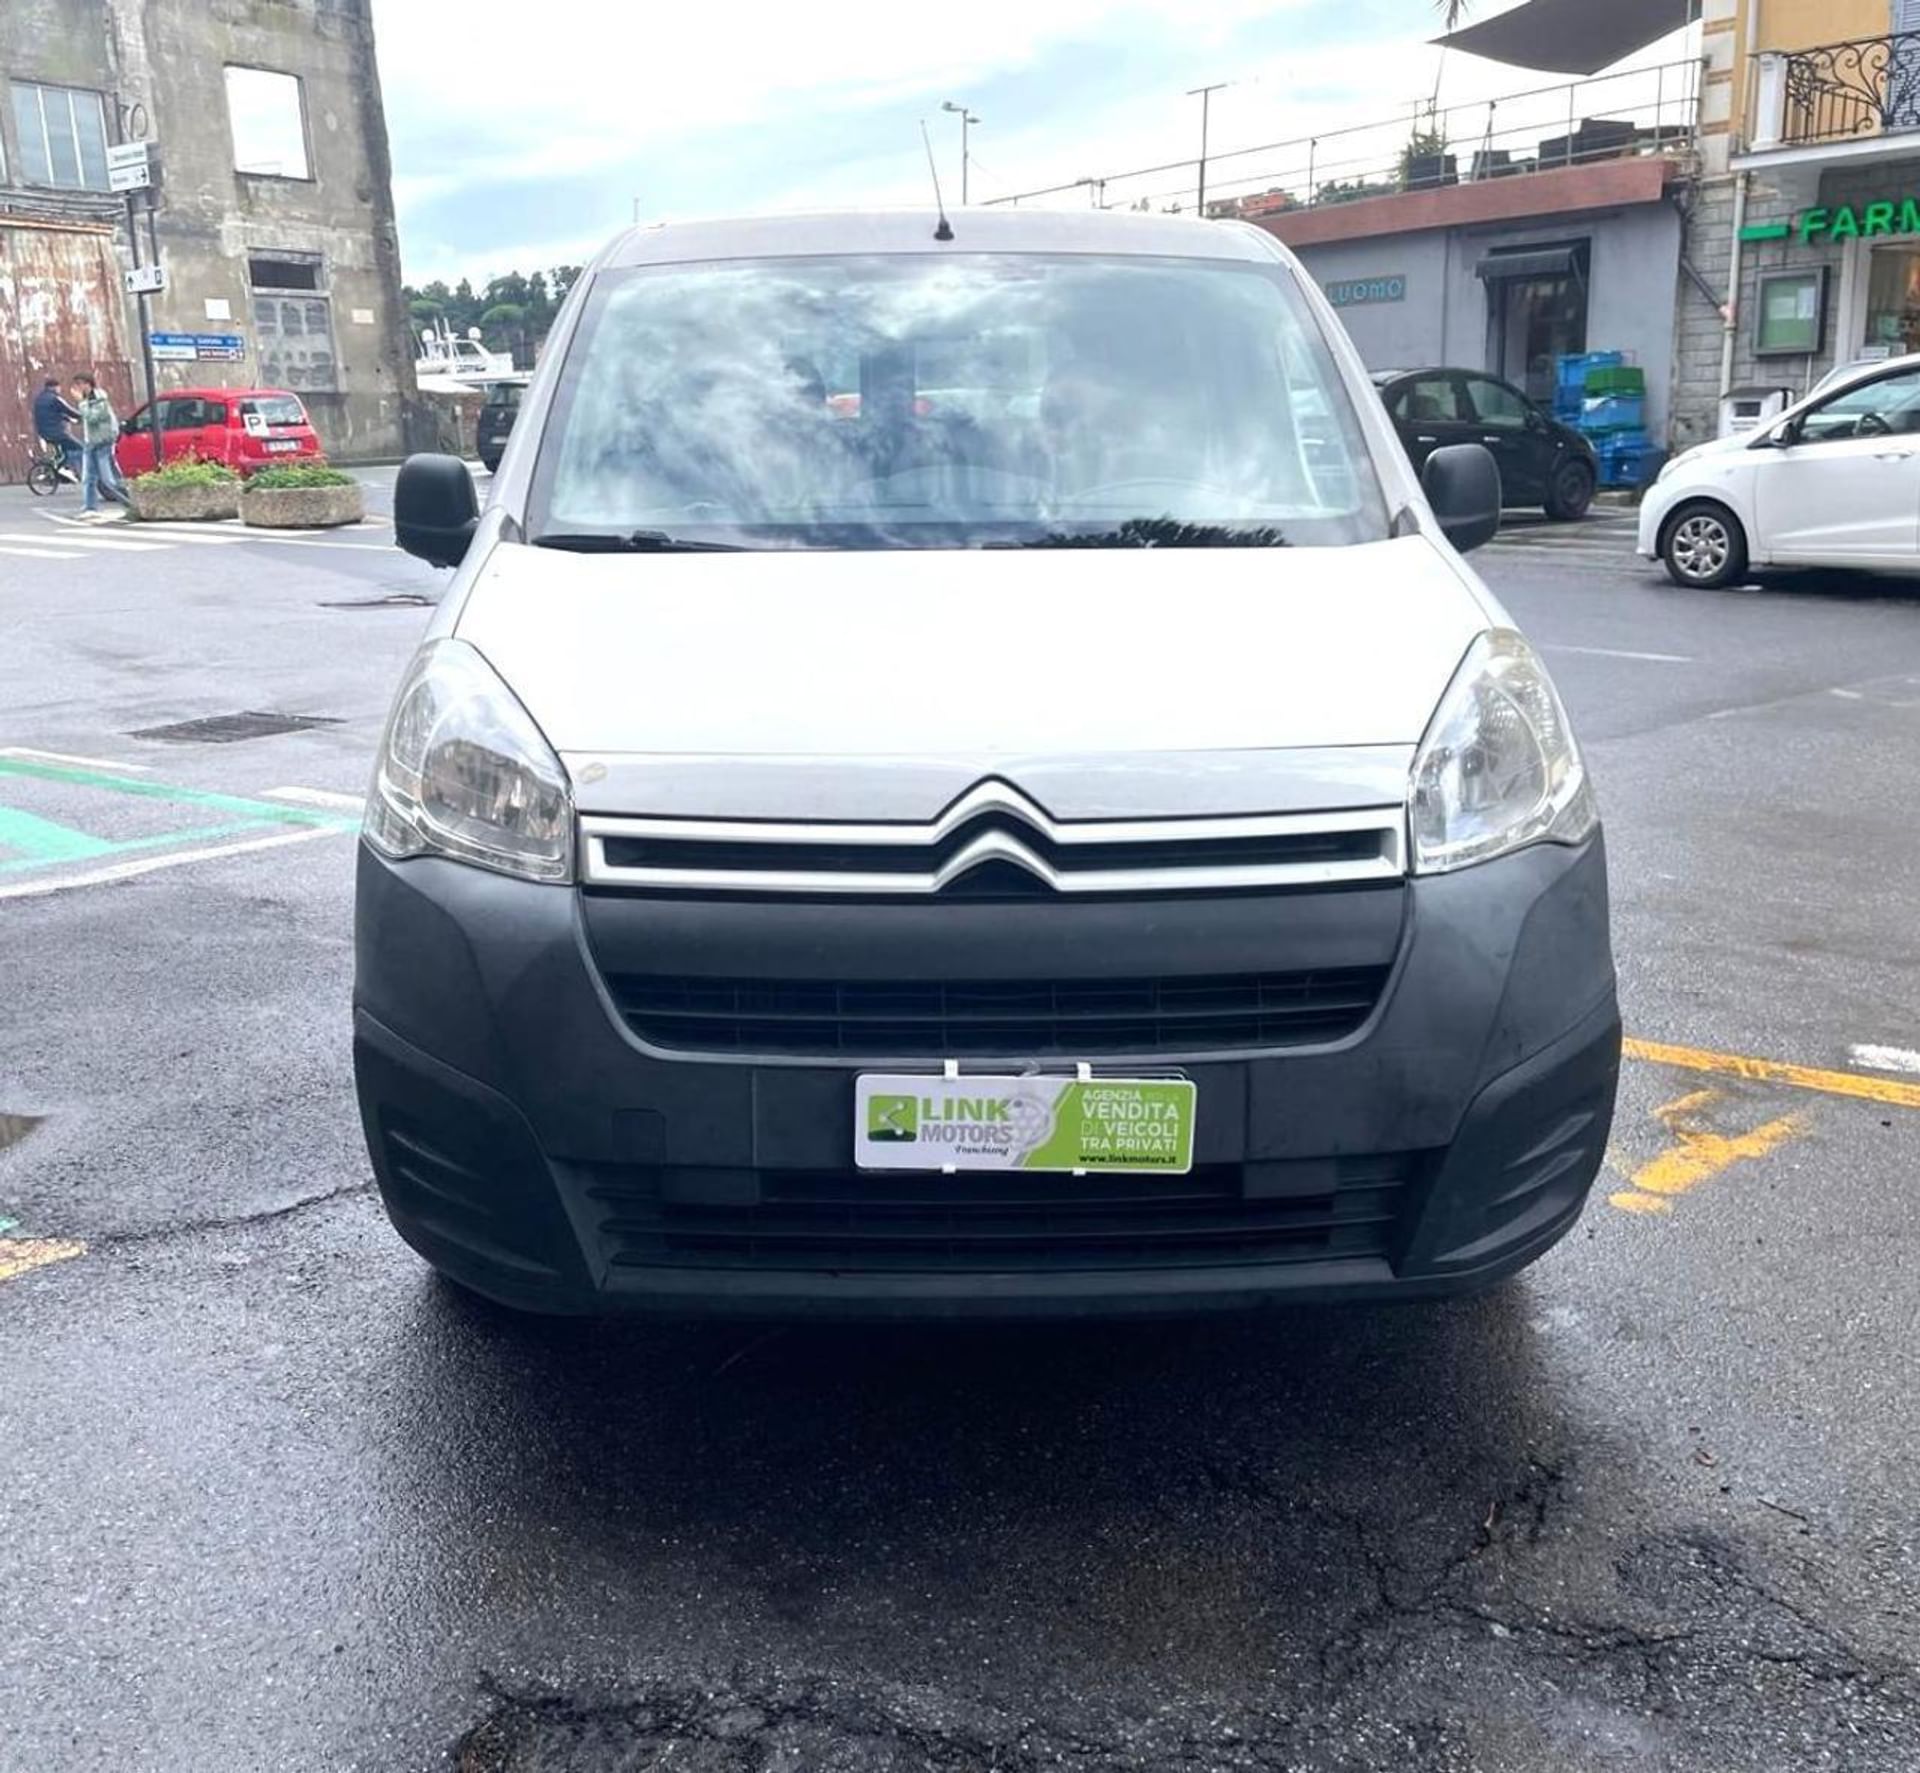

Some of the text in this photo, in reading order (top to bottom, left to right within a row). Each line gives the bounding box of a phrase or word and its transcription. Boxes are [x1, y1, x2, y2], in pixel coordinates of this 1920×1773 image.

[1799, 196, 1920, 244] FARM
[248, 416, 262, 433] P
[1082, 1089, 1142, 1101] AGENZIA
[921, 1098, 1012, 1121] LINK
[1082, 1101, 1179, 1120] VENDITA
[920, 1124, 1013, 1144] MOTORS
[1081, 1121, 1178, 1137] DI VEICOLI
[1080, 1137, 1177, 1152] TRA PRIVATI
